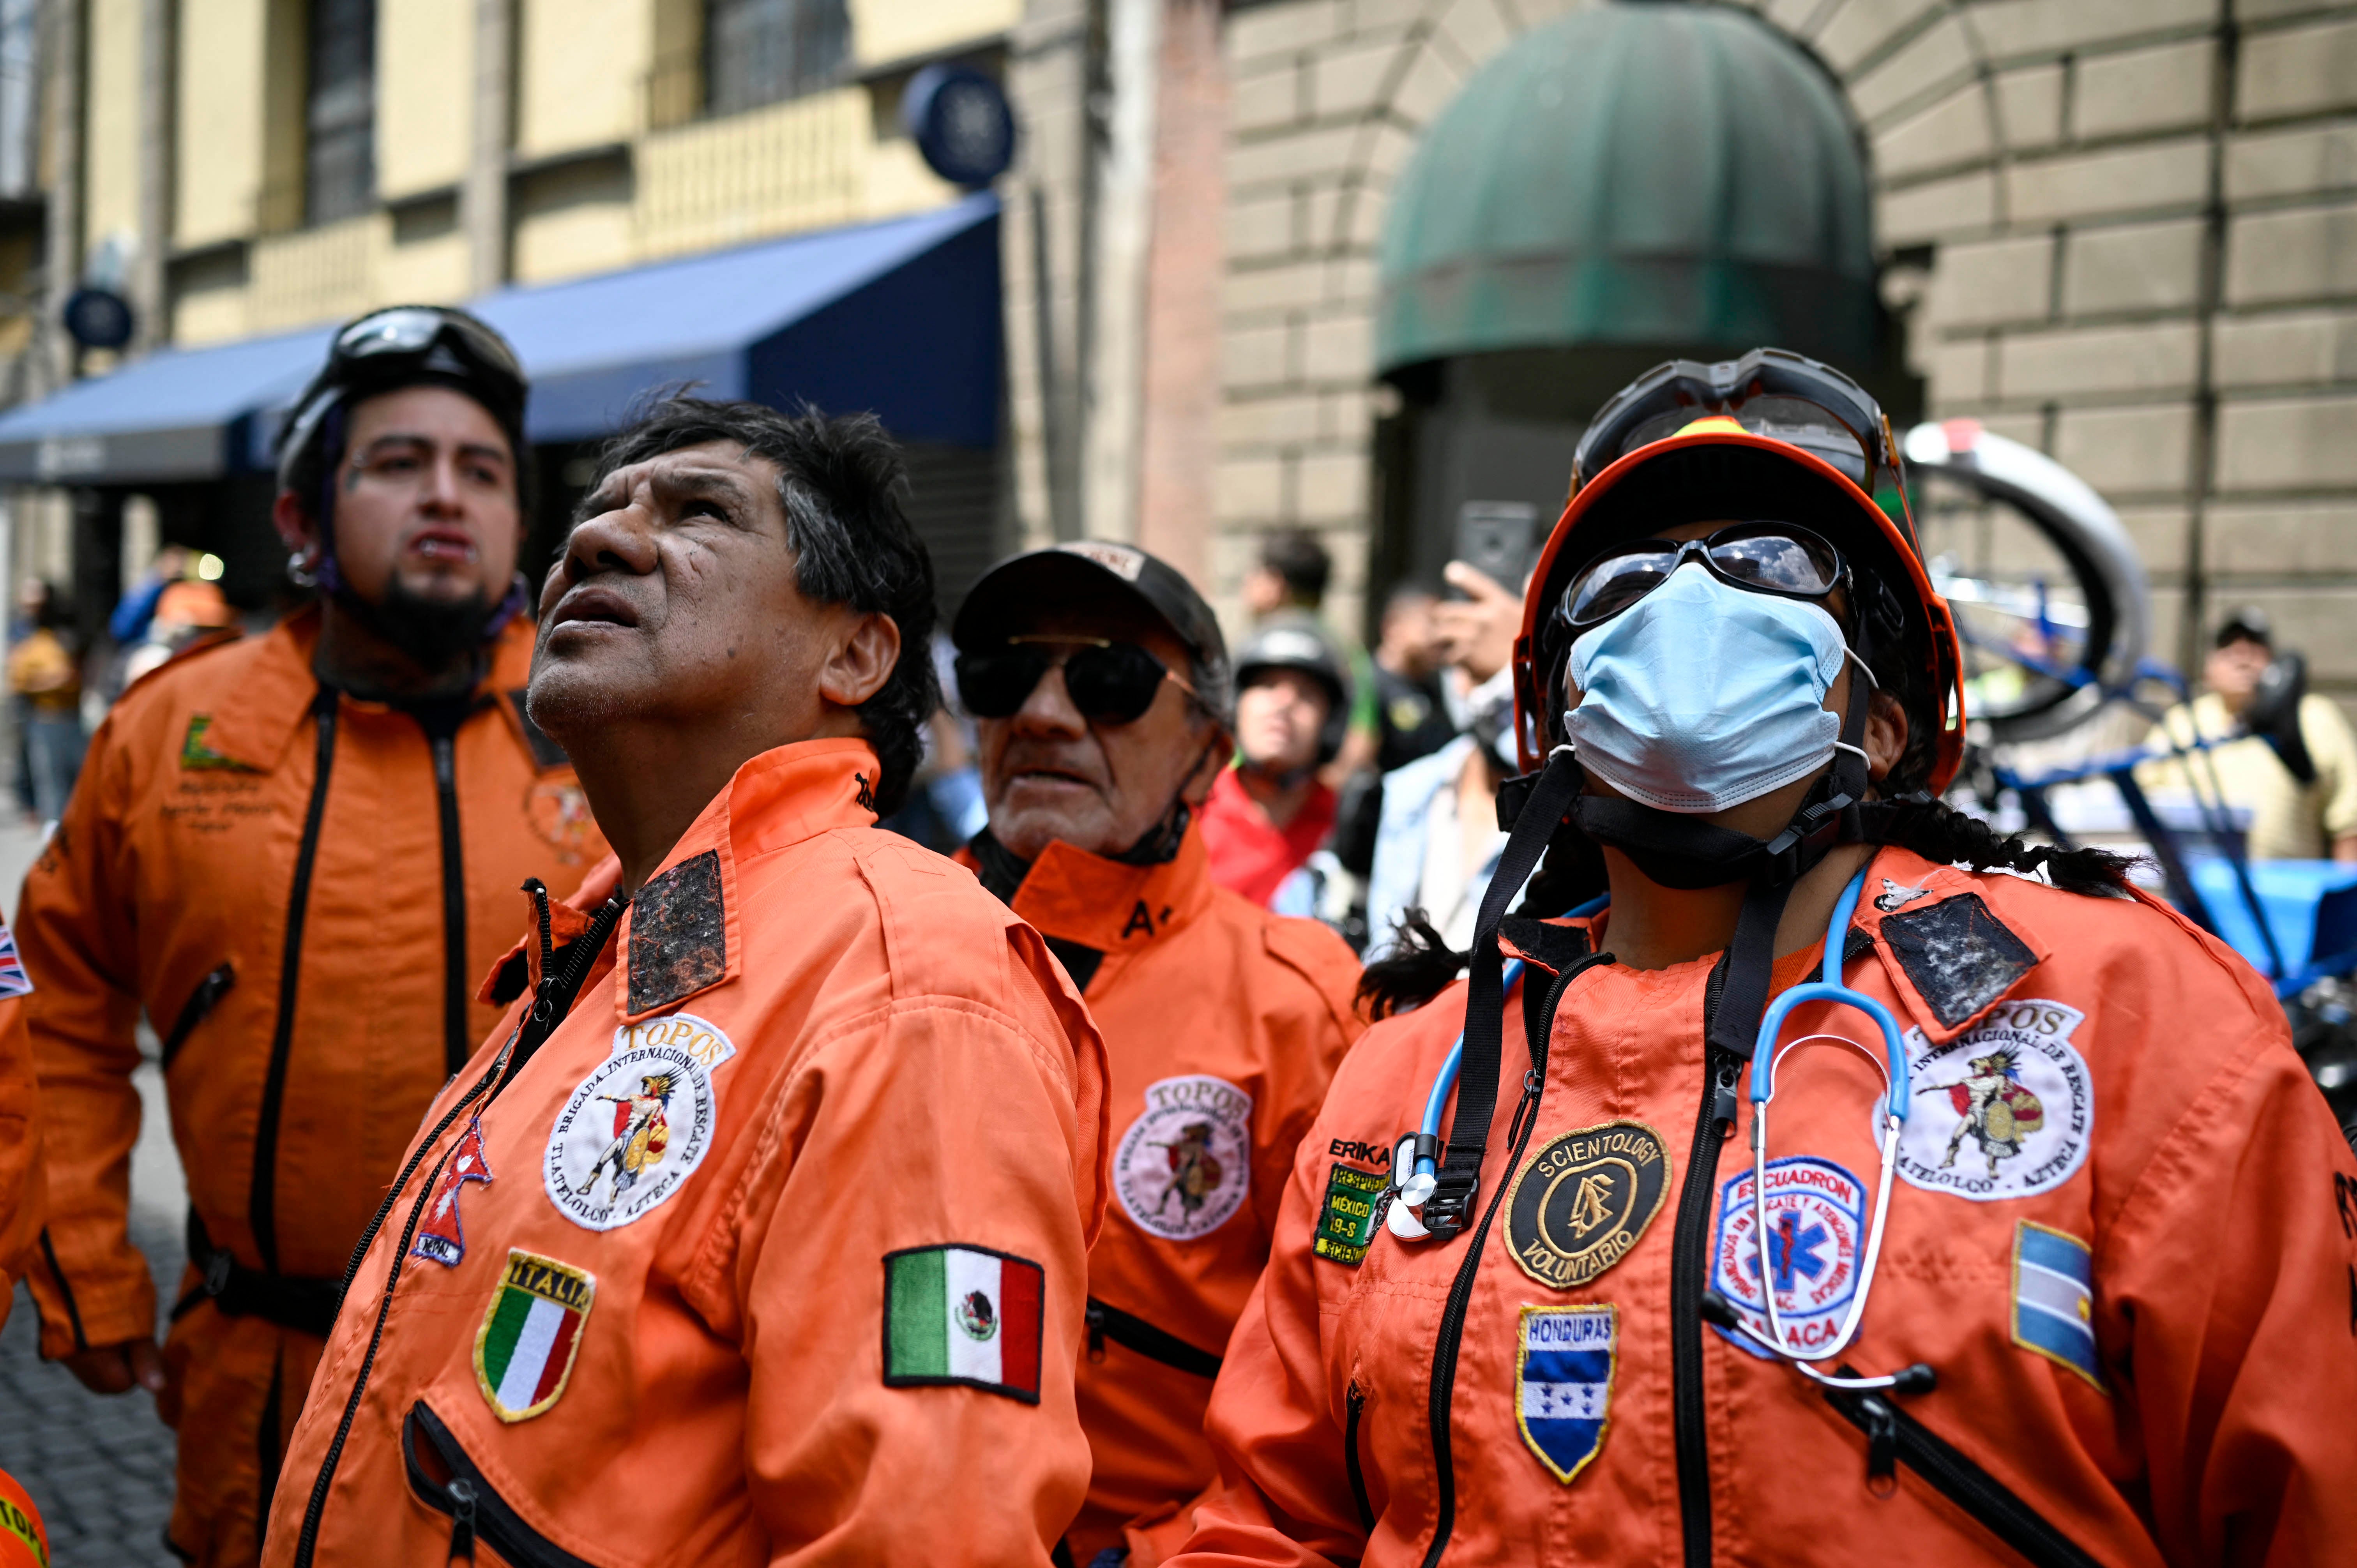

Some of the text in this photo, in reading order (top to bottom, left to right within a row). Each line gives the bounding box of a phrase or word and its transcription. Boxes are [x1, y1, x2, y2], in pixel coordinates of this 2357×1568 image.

[622, 1021, 724, 1066] TOPOS
[1151, 1081, 1249, 1121] TOPOS
[1913, 1030, 2085, 1135] INTERNACIONAL DE RESCATE
[559, 1047, 709, 1165] BRIGADA INTERNACIONAL DE RESCATE
[1328, 1138, 1390, 1166] ERIKA
[1537, 1133, 1661, 1178] SCIENTOLOGY
[1898, 1140, 2079, 1193] ATELOLCO AZTECA
[551, 1142, 680, 1222] TLATELOLCO AZTECA
[1329, 1217, 1357, 1238] 19-S
[1330, 1194, 1370, 1218] MÉXICO
[1733, 1217, 1750, 1232] EN
[1804, 1196, 1811, 1207] Y
[1522, 1230, 1635, 1281] VOLUNTARIO
[511, 1263, 590, 1310] ITALIA
[1529, 1317, 1612, 1342] HONDURAS
